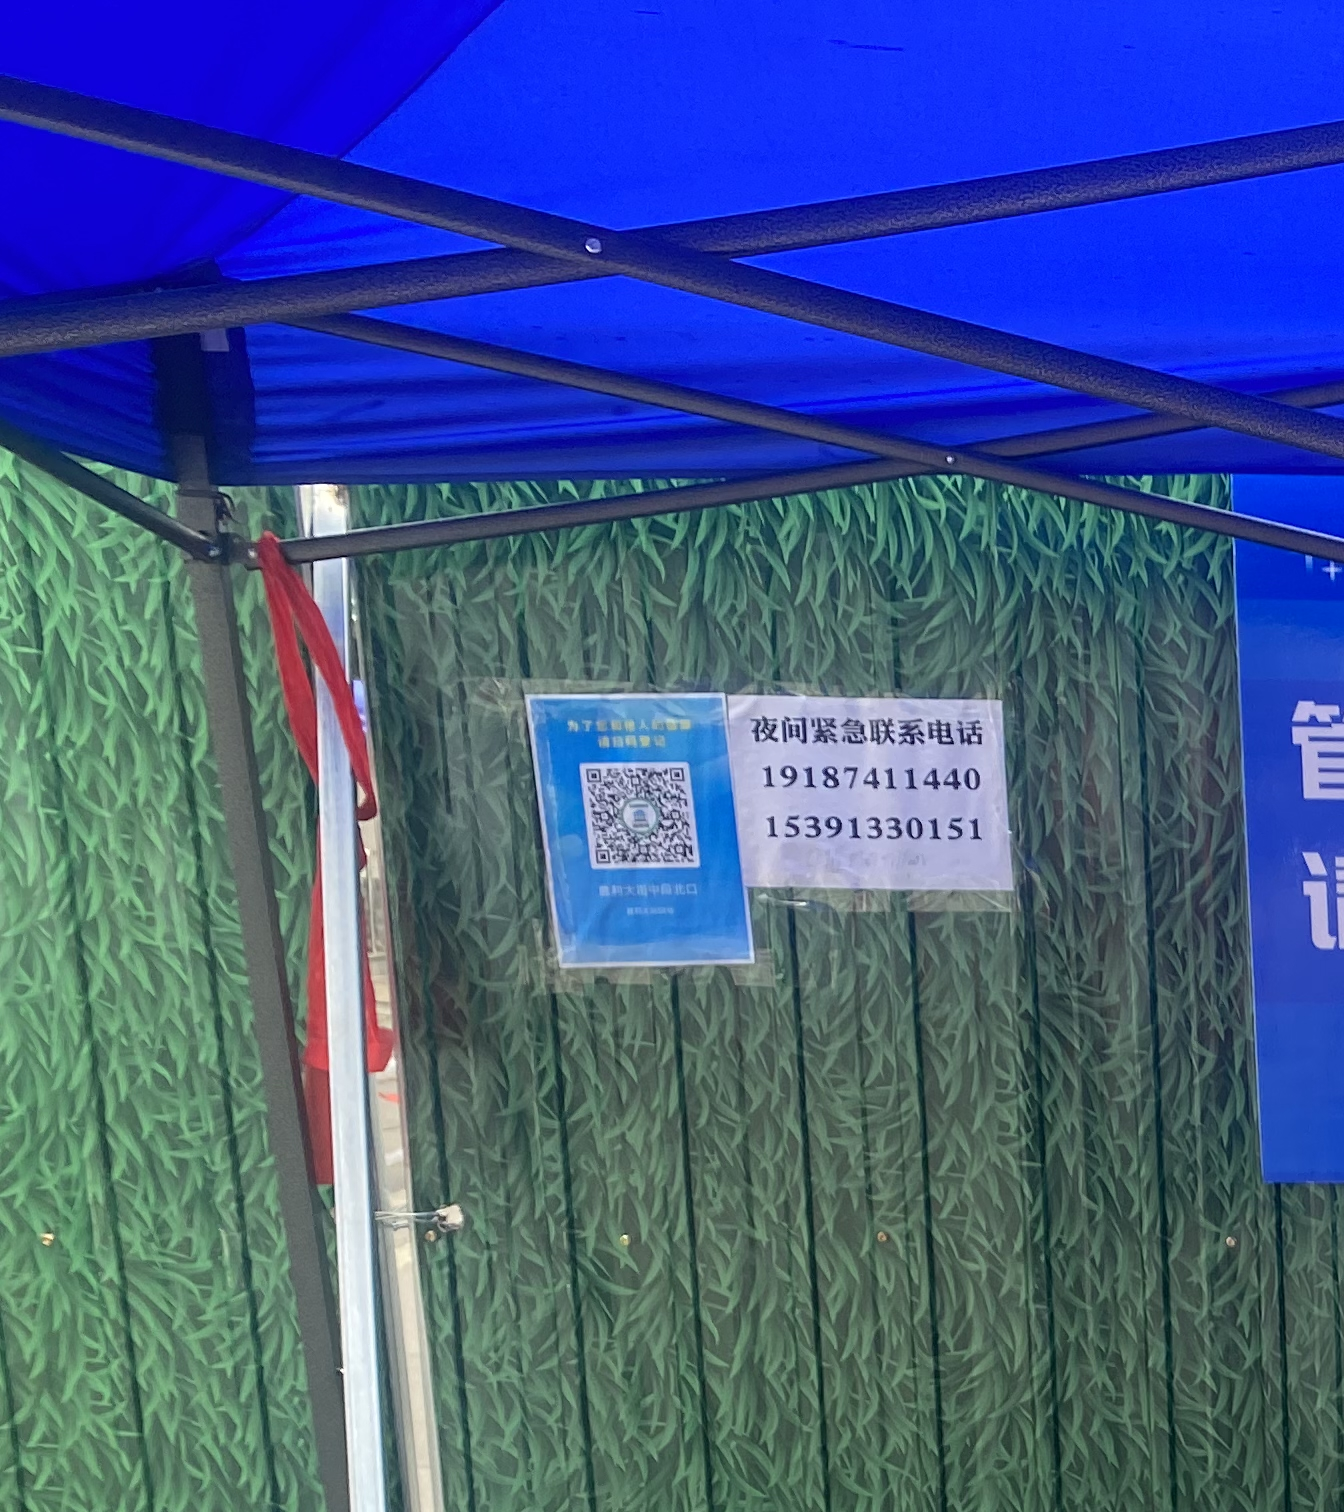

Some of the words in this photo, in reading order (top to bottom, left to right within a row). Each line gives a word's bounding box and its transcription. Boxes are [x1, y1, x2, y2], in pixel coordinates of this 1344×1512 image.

[750, 716, 983, 746] 夜间紧急联系电话
[762, 765, 981, 790] 19187411440
[766, 815, 983, 840] 15391330151
